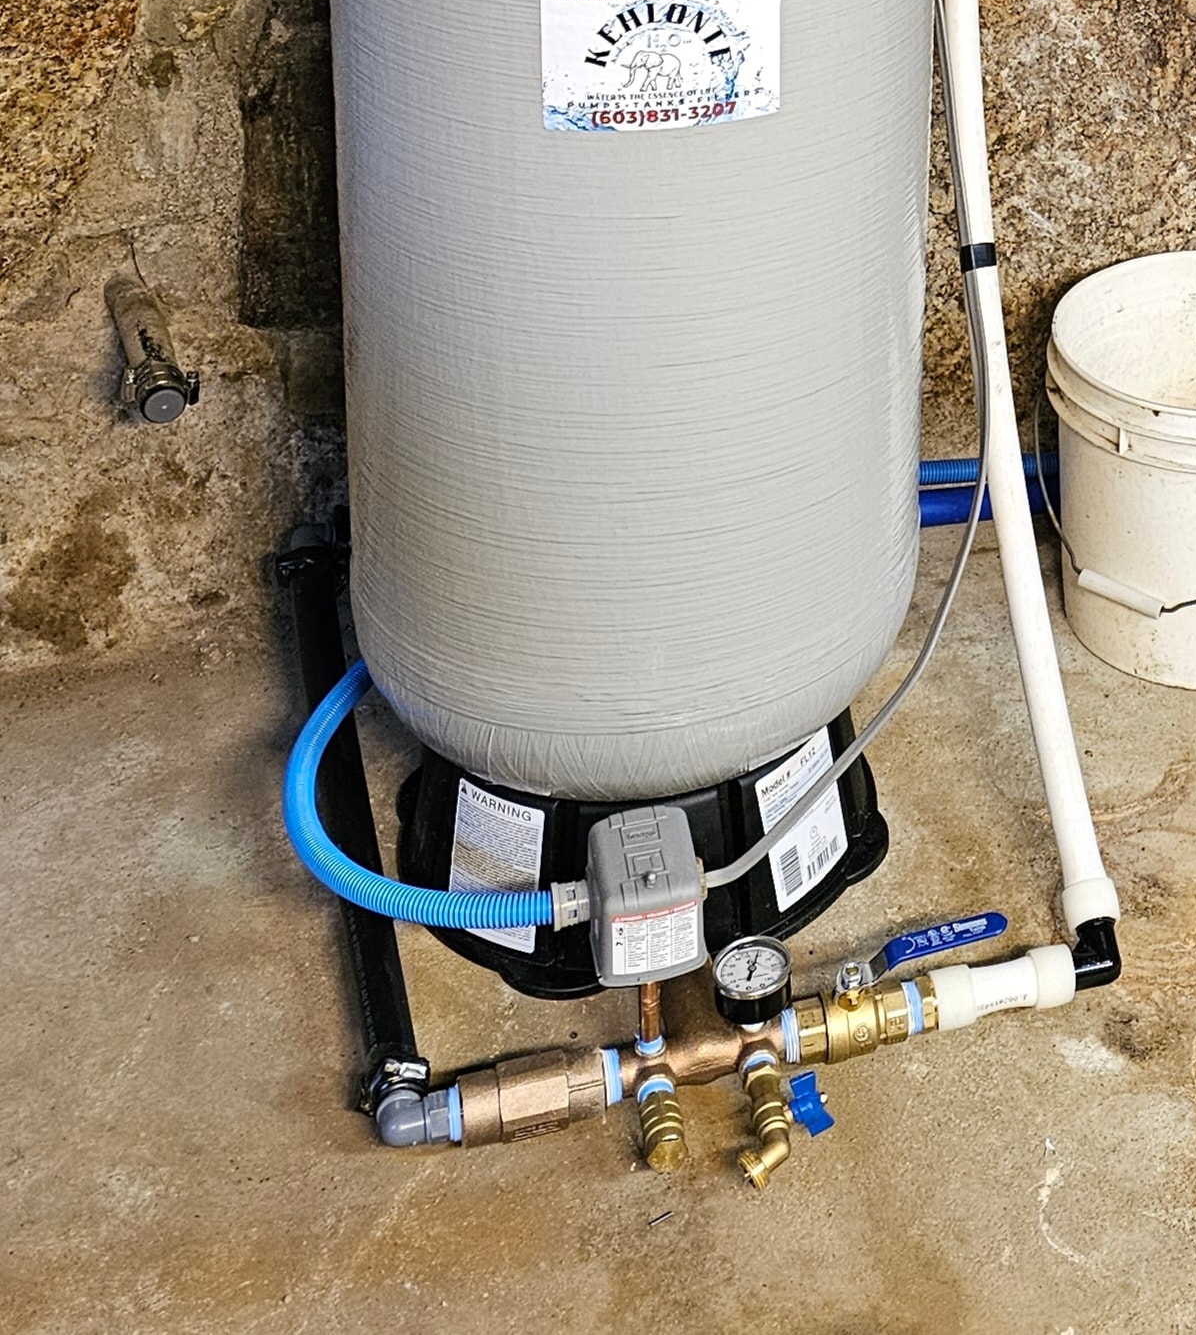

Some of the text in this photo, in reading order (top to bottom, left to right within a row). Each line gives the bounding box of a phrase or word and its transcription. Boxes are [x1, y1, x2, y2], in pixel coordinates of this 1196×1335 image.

[591, 101, 737, 128] (603)831-3207
[761, 774, 785, 797] Model
[471, 788, 532, 822] WARNING
